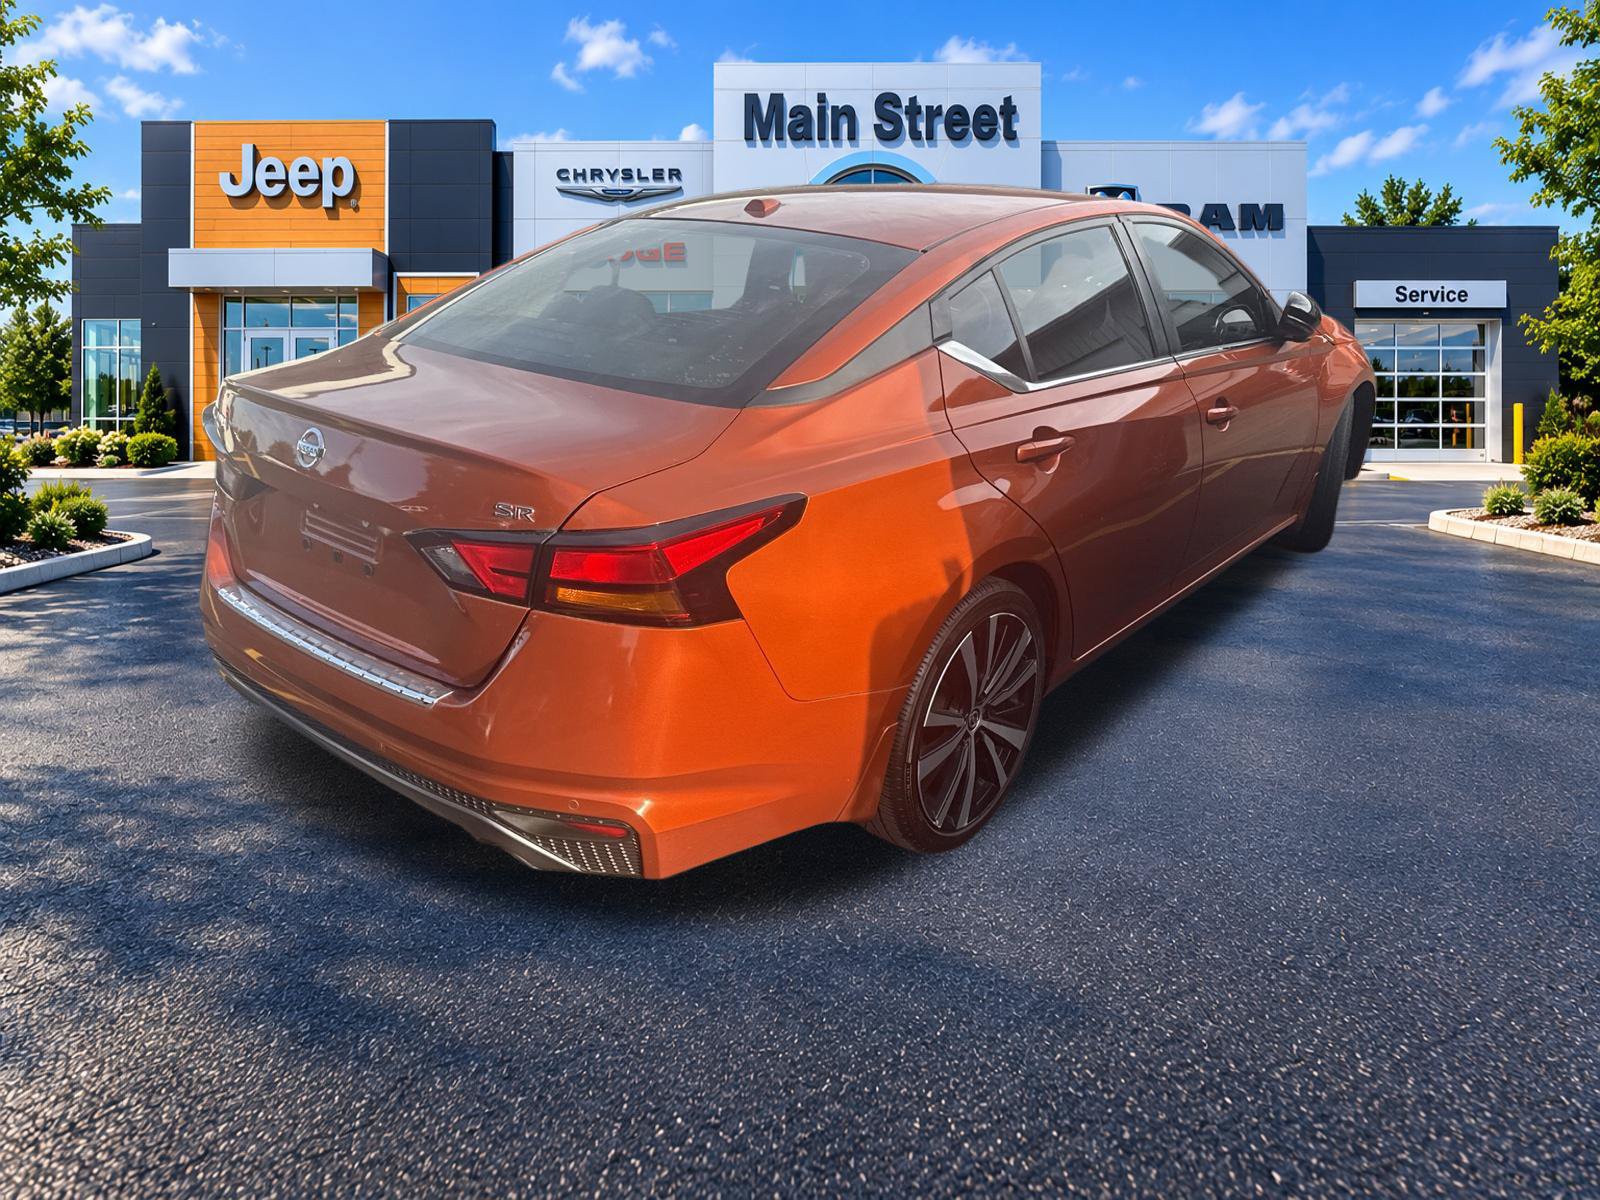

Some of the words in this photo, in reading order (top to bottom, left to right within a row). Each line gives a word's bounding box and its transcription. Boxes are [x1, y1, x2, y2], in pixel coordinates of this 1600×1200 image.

[744, 92, 857, 141] Main
[873, 91, 1018, 141] Street
[219, 143, 355, 208] Jeep
[556, 168, 683, 182] CHRYSLER
[1395, 285, 1469, 303] Service
[494, 502, 536, 523] SR
